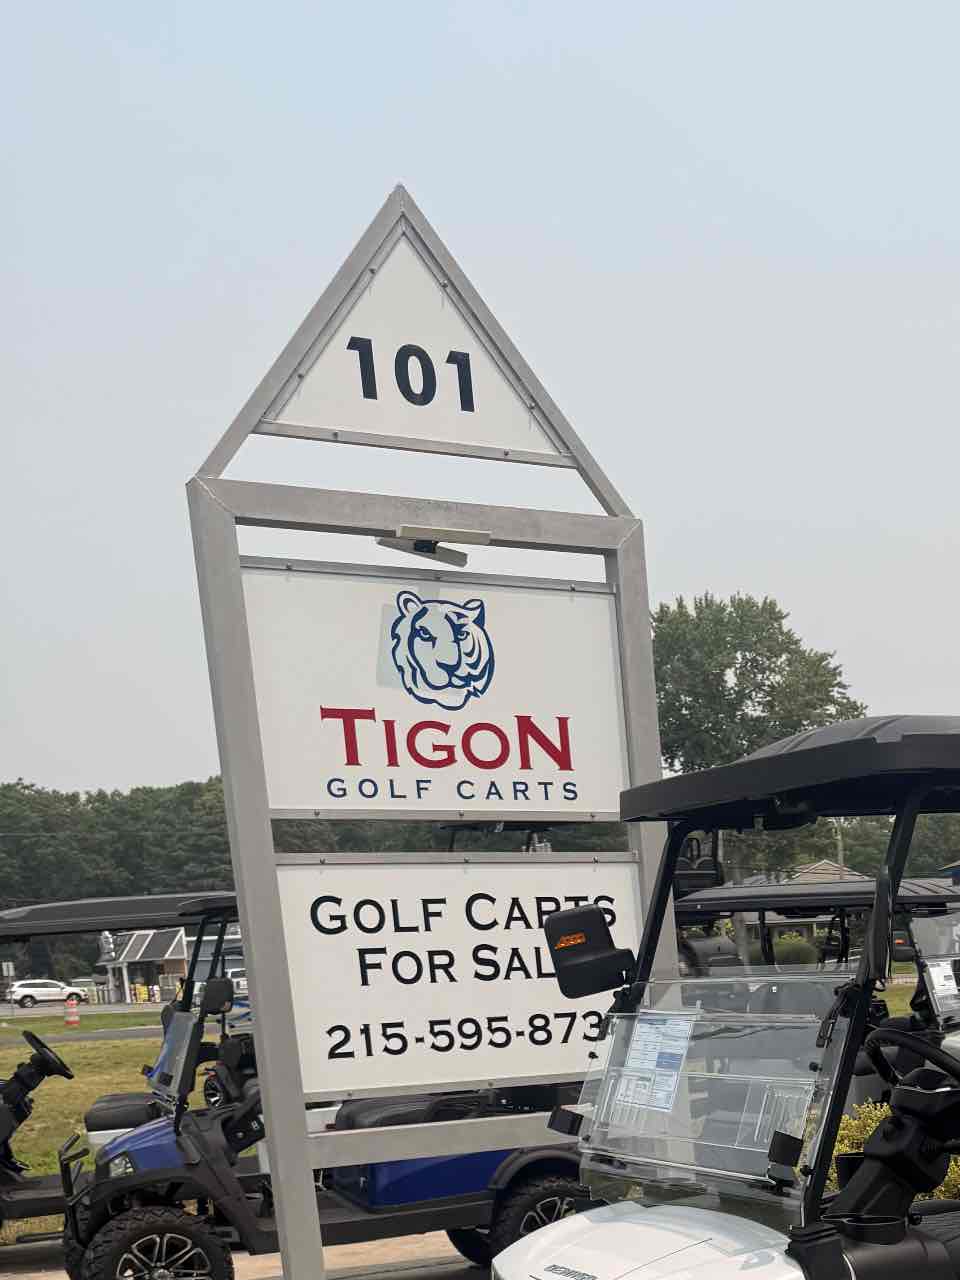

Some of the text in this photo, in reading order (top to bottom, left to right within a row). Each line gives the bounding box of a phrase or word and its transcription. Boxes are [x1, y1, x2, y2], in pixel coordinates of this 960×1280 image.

[346, 336, 475, 413] 101
[319, 705, 574, 772] TIGON
[326, 777, 578, 801] GOLF CARTS
[310, 895, 447, 935] GOLF
[356, 943, 557, 987] FOR SAL
[326, 1010, 606, 1060] 215-595-873
